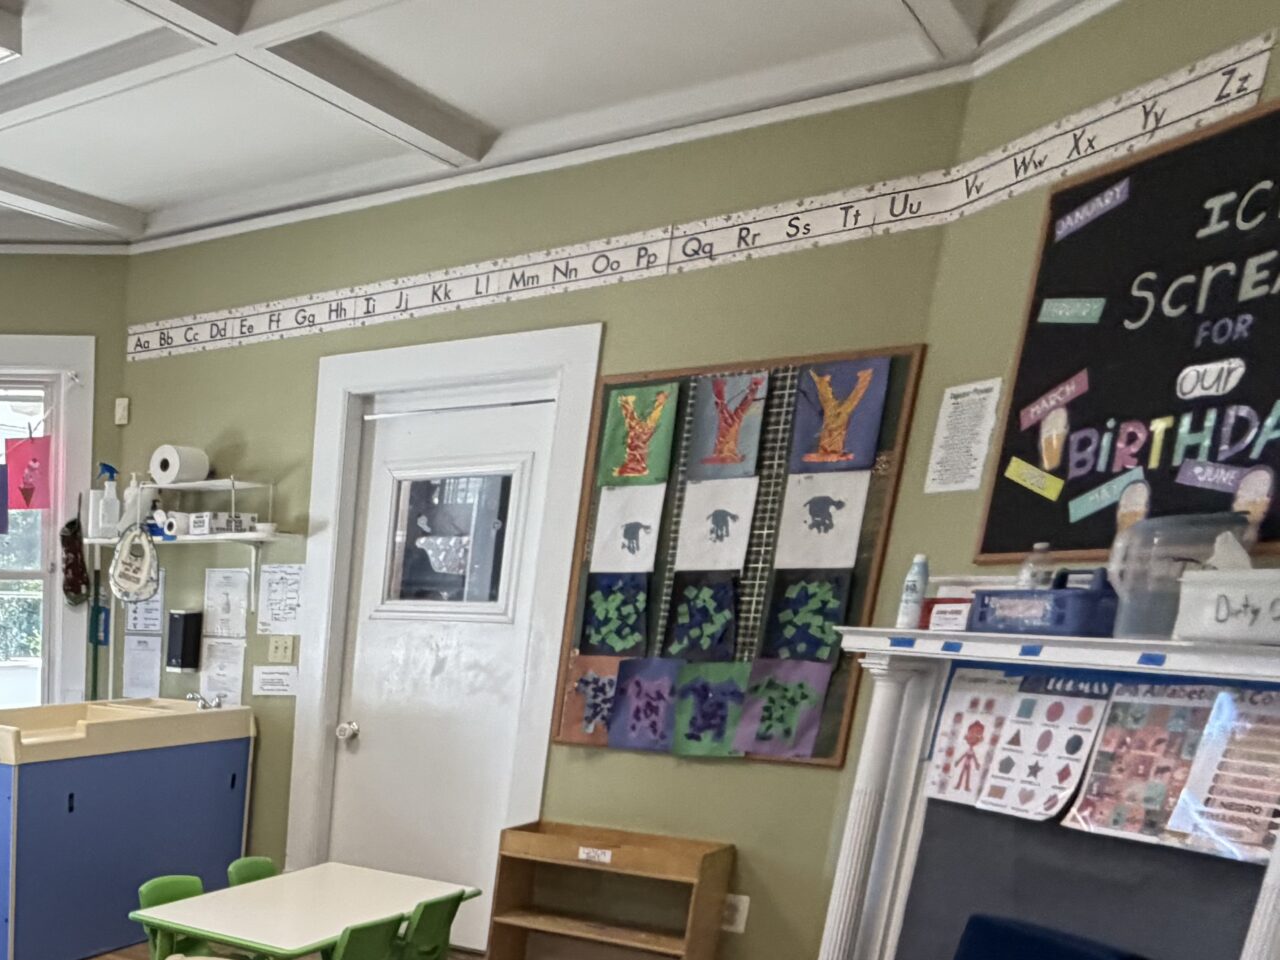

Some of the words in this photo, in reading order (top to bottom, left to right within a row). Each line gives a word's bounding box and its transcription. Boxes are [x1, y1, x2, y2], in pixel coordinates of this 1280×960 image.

[134, 336, 150, 350] Aa
[159, 329, 174, 347] Bb
[184, 327, 199, 343] Cc
[210, 323, 227, 339] Dd
[240, 319, 254, 335] Ee
[294, 309, 316, 327] Gg
[328, 301, 347, 321] Hh
[395, 291, 409, 312] Jj
[431, 283, 452, 303] Kk
[509, 271, 540, 290] Mm
[553, 261, 578, 282] Nn
[592, 254, 620, 274] Oo
[636, 246, 658, 270] Pp
[681, 237, 716, 261] Qq
[737, 227, 760, 248] Rr
[786, 216, 811, 238] Ss
[840, 205, 861, 227] Tt
[889, 193, 922, 218] Uu
[965, 174, 984, 199] Vv
[1013, 149, 1048, 179] Ww
[1067, 128, 1096, 159] Xx
[1142, 101, 1167, 142] Yy
[1214, 67, 1253, 102] Zz
[1195, 179, 1280, 239] IC
[1194, 313, 1254, 348] FOR
